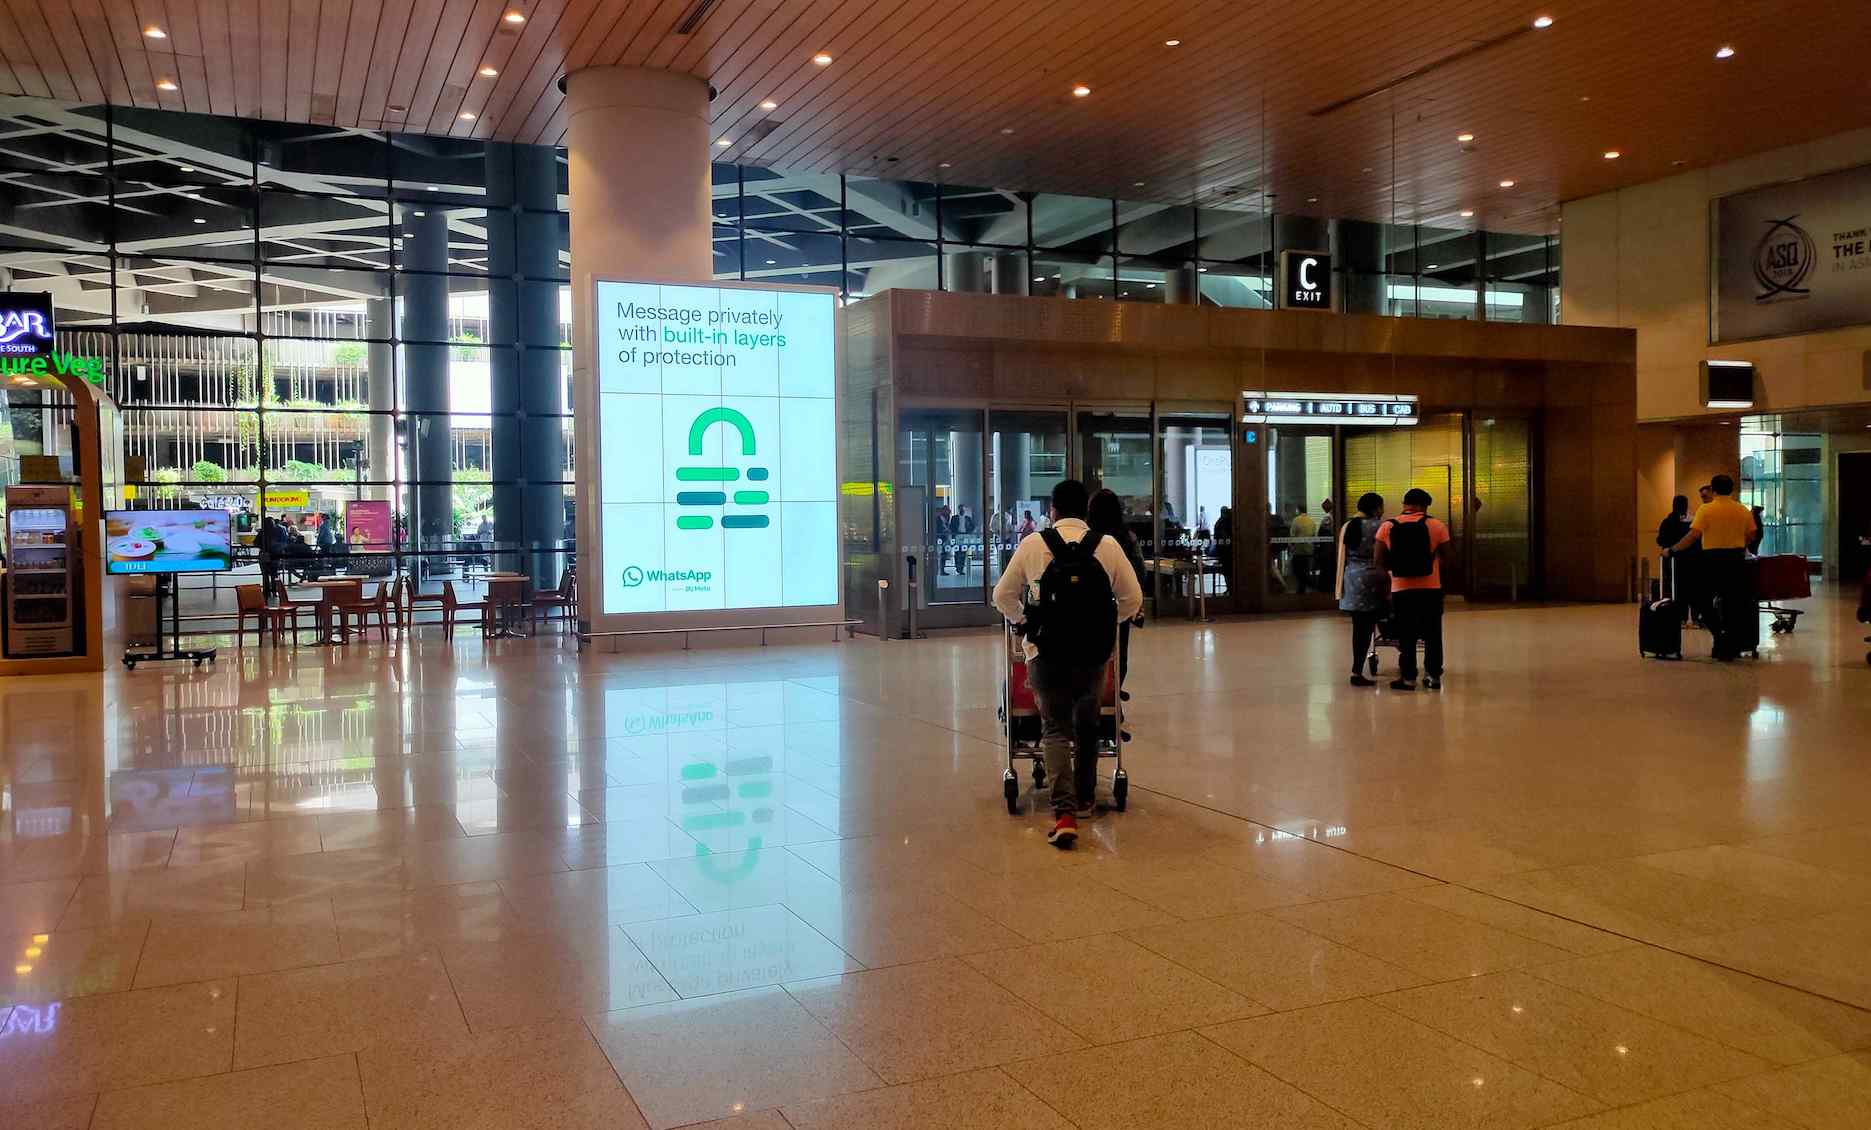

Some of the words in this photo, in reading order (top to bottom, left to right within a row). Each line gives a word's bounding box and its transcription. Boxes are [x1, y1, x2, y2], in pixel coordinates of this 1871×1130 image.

[1833, 242, 1864, 258] THE
[1300, 258, 1318, 290] C
[1295, 291, 1322, 302] EXIT
[616, 302, 702, 325] Message
[708, 307, 783, 329] privately
[618, 325, 657, 342] with
[664, 326, 728, 345] built-in
[734, 328, 787, 350] layers
[7, 344, 36, 353] SOUTH
[618, 347, 637, 363] of
[643, 350, 736, 368] protection
[50, 350, 104, 384] Veg
[1319, 403, 1343, 413] AUTO
[1359, 404, 1377, 414] BUS
[1392, 404, 1412, 415] CAB
[646, 569, 712, 583] WhatsApp
